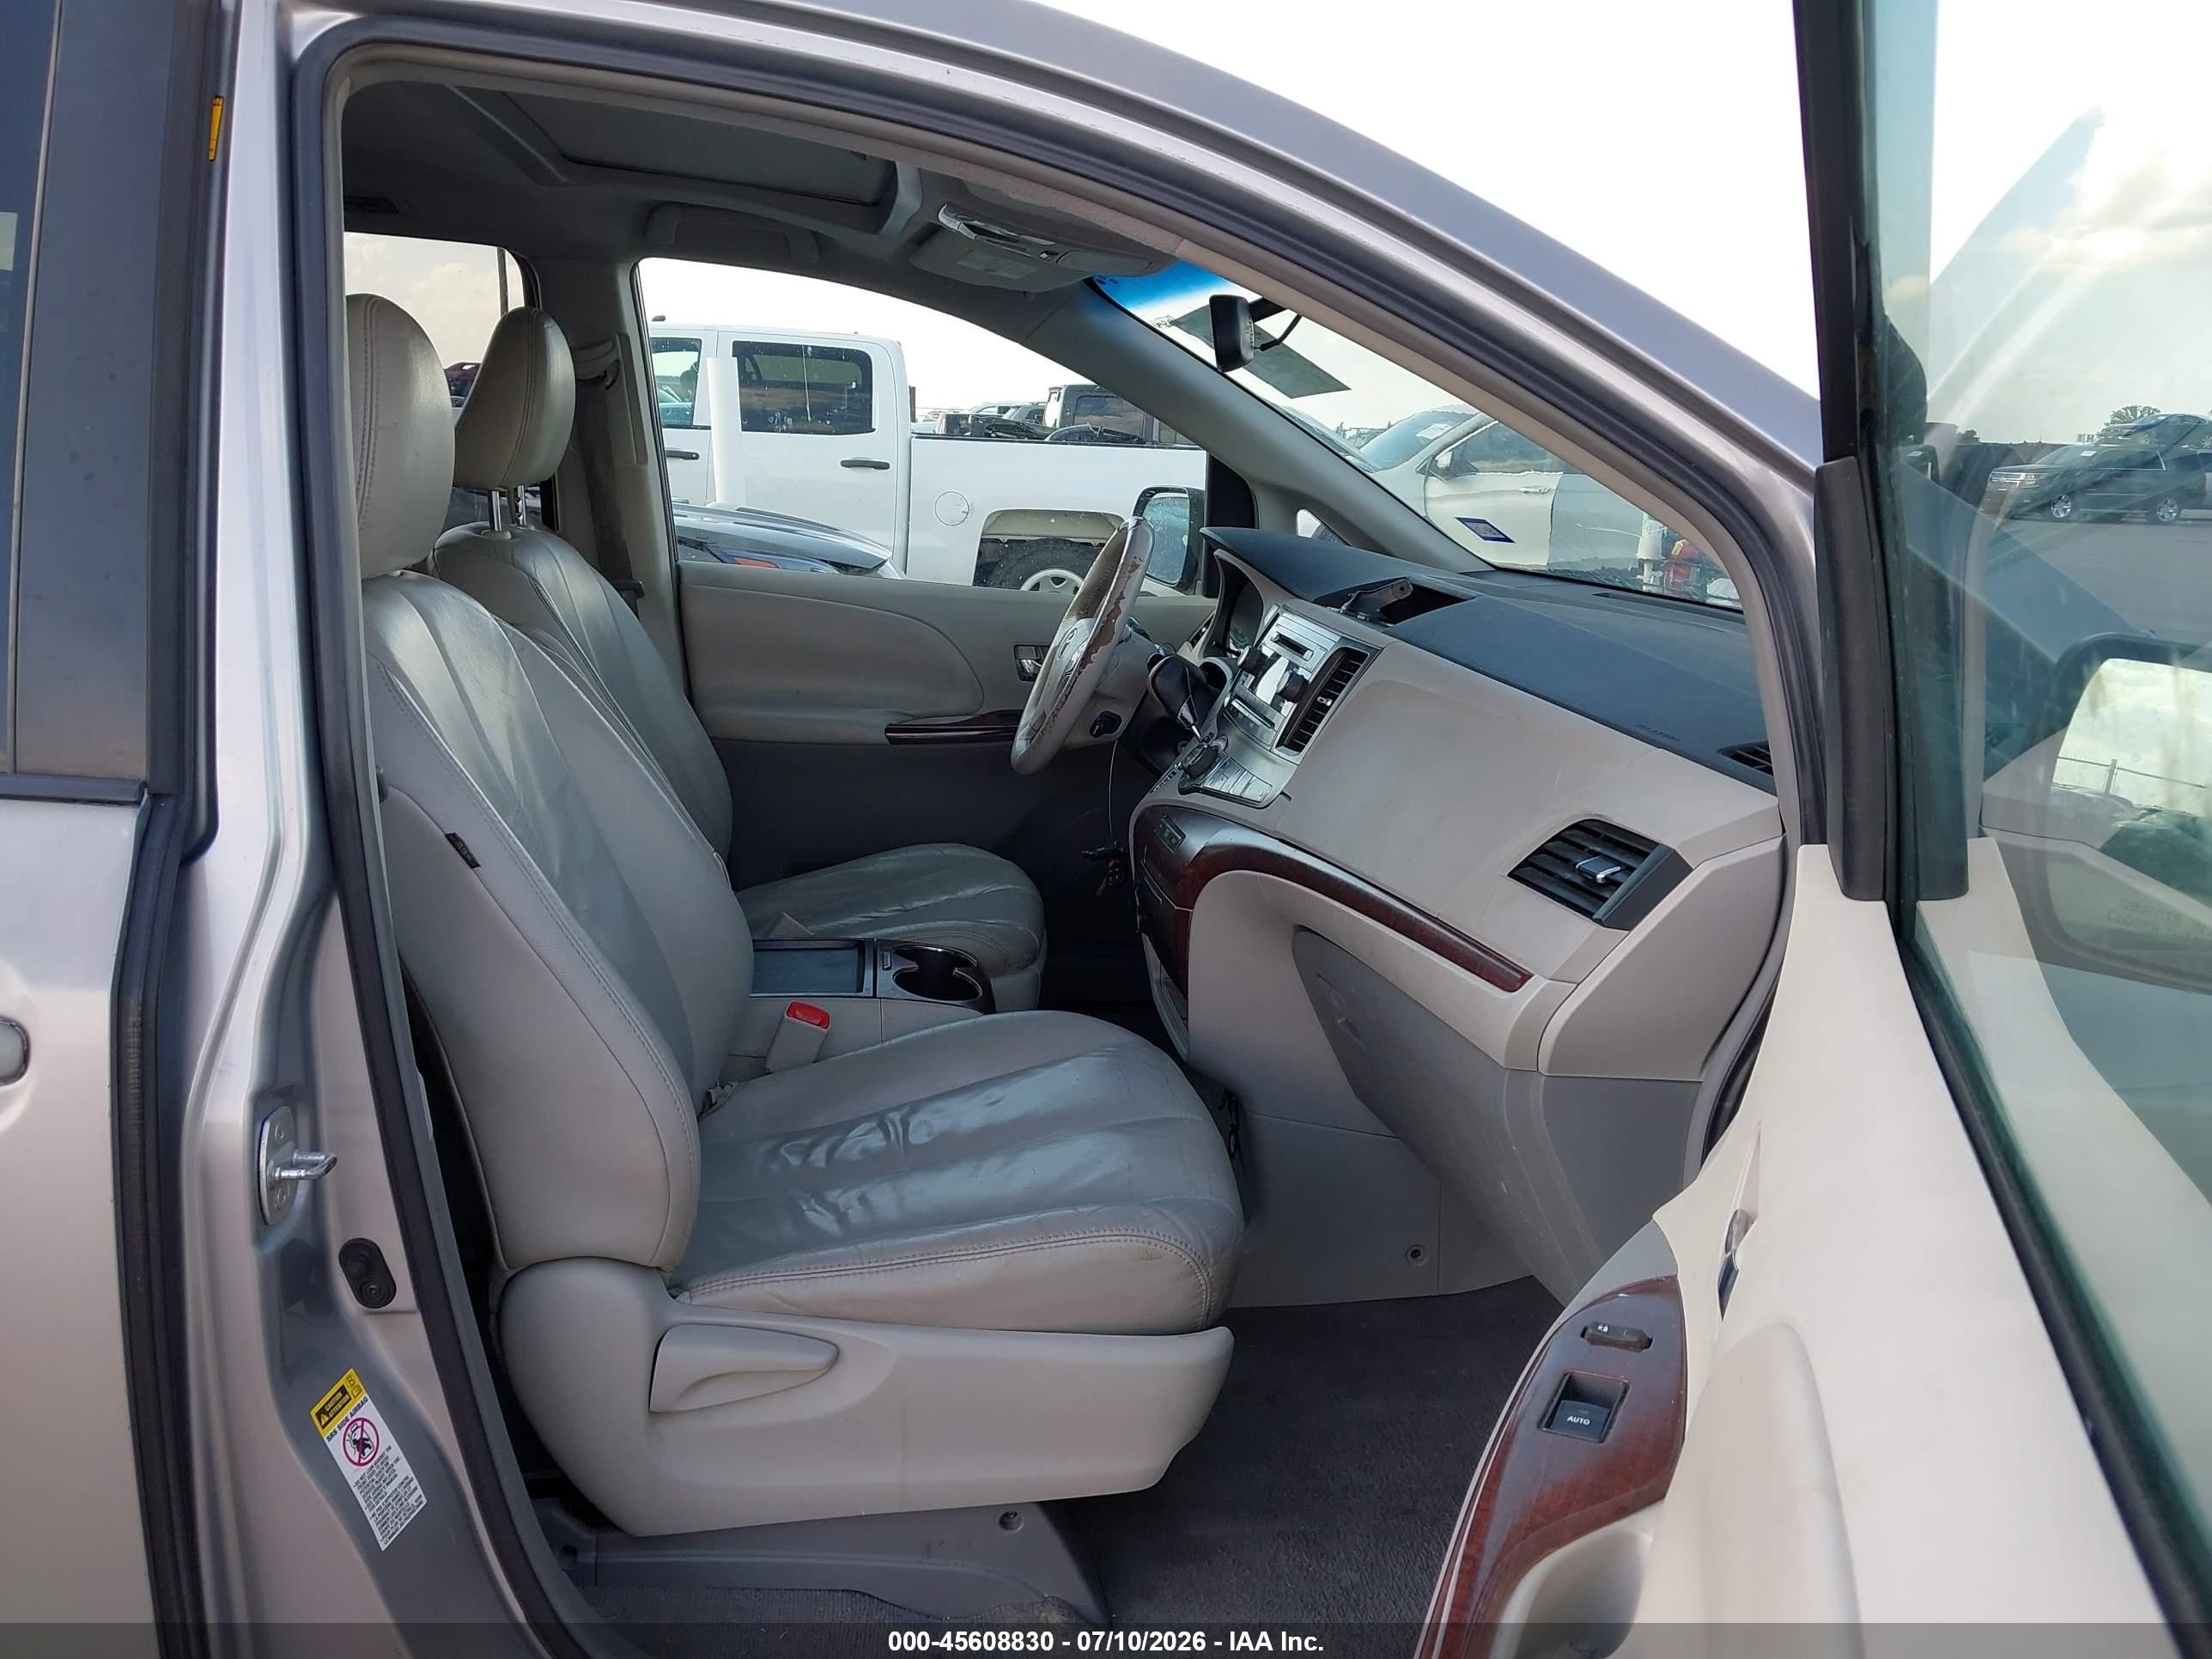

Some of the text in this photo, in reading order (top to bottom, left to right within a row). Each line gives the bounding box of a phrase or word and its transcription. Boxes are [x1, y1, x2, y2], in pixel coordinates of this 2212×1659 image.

[325, 1391, 343, 1413] CAUTION
[328, 1394, 349, 1419] ATTENTION
[326, 1396, 368, 1443] SRS SIDE AIRBAG
[1567, 1415, 1590, 1425] AUTO
